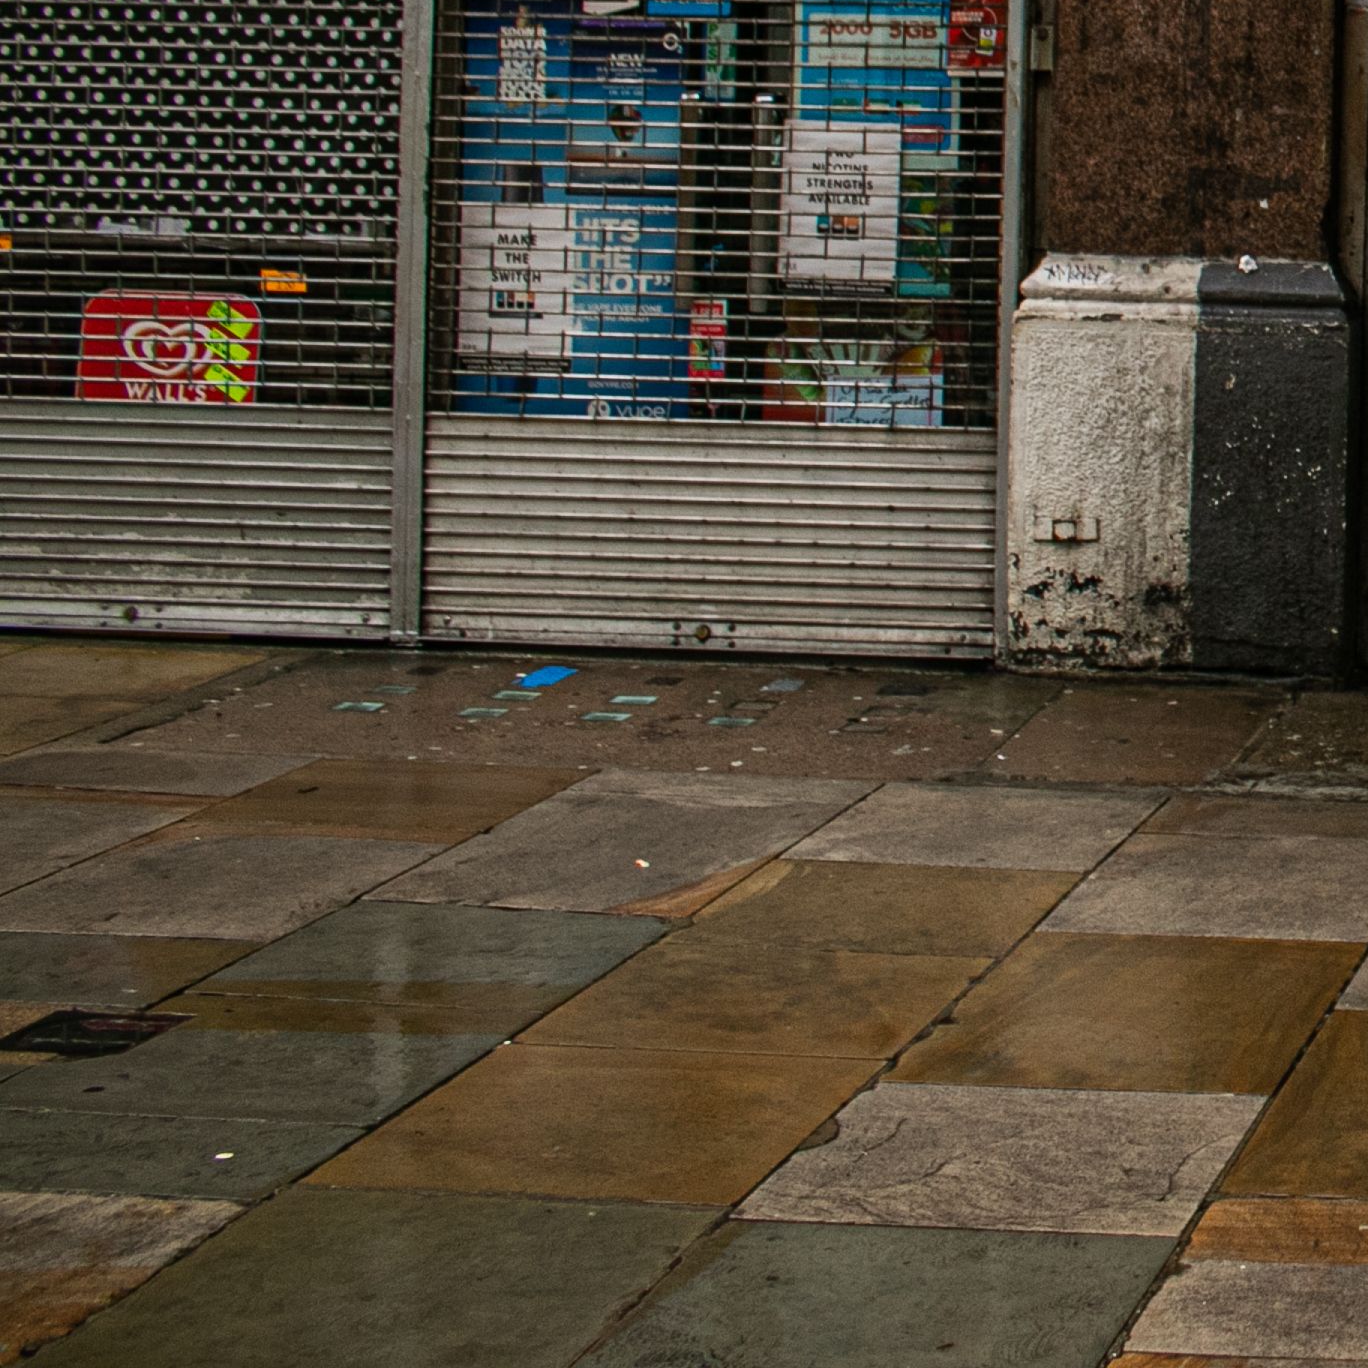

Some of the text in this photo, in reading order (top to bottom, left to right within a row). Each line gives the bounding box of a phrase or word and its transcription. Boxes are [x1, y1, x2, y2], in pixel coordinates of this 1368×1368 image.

[497, 233, 537, 247] MAKE
[505, 252, 530, 265] THE
[491, 270, 541, 283] SWITCH
